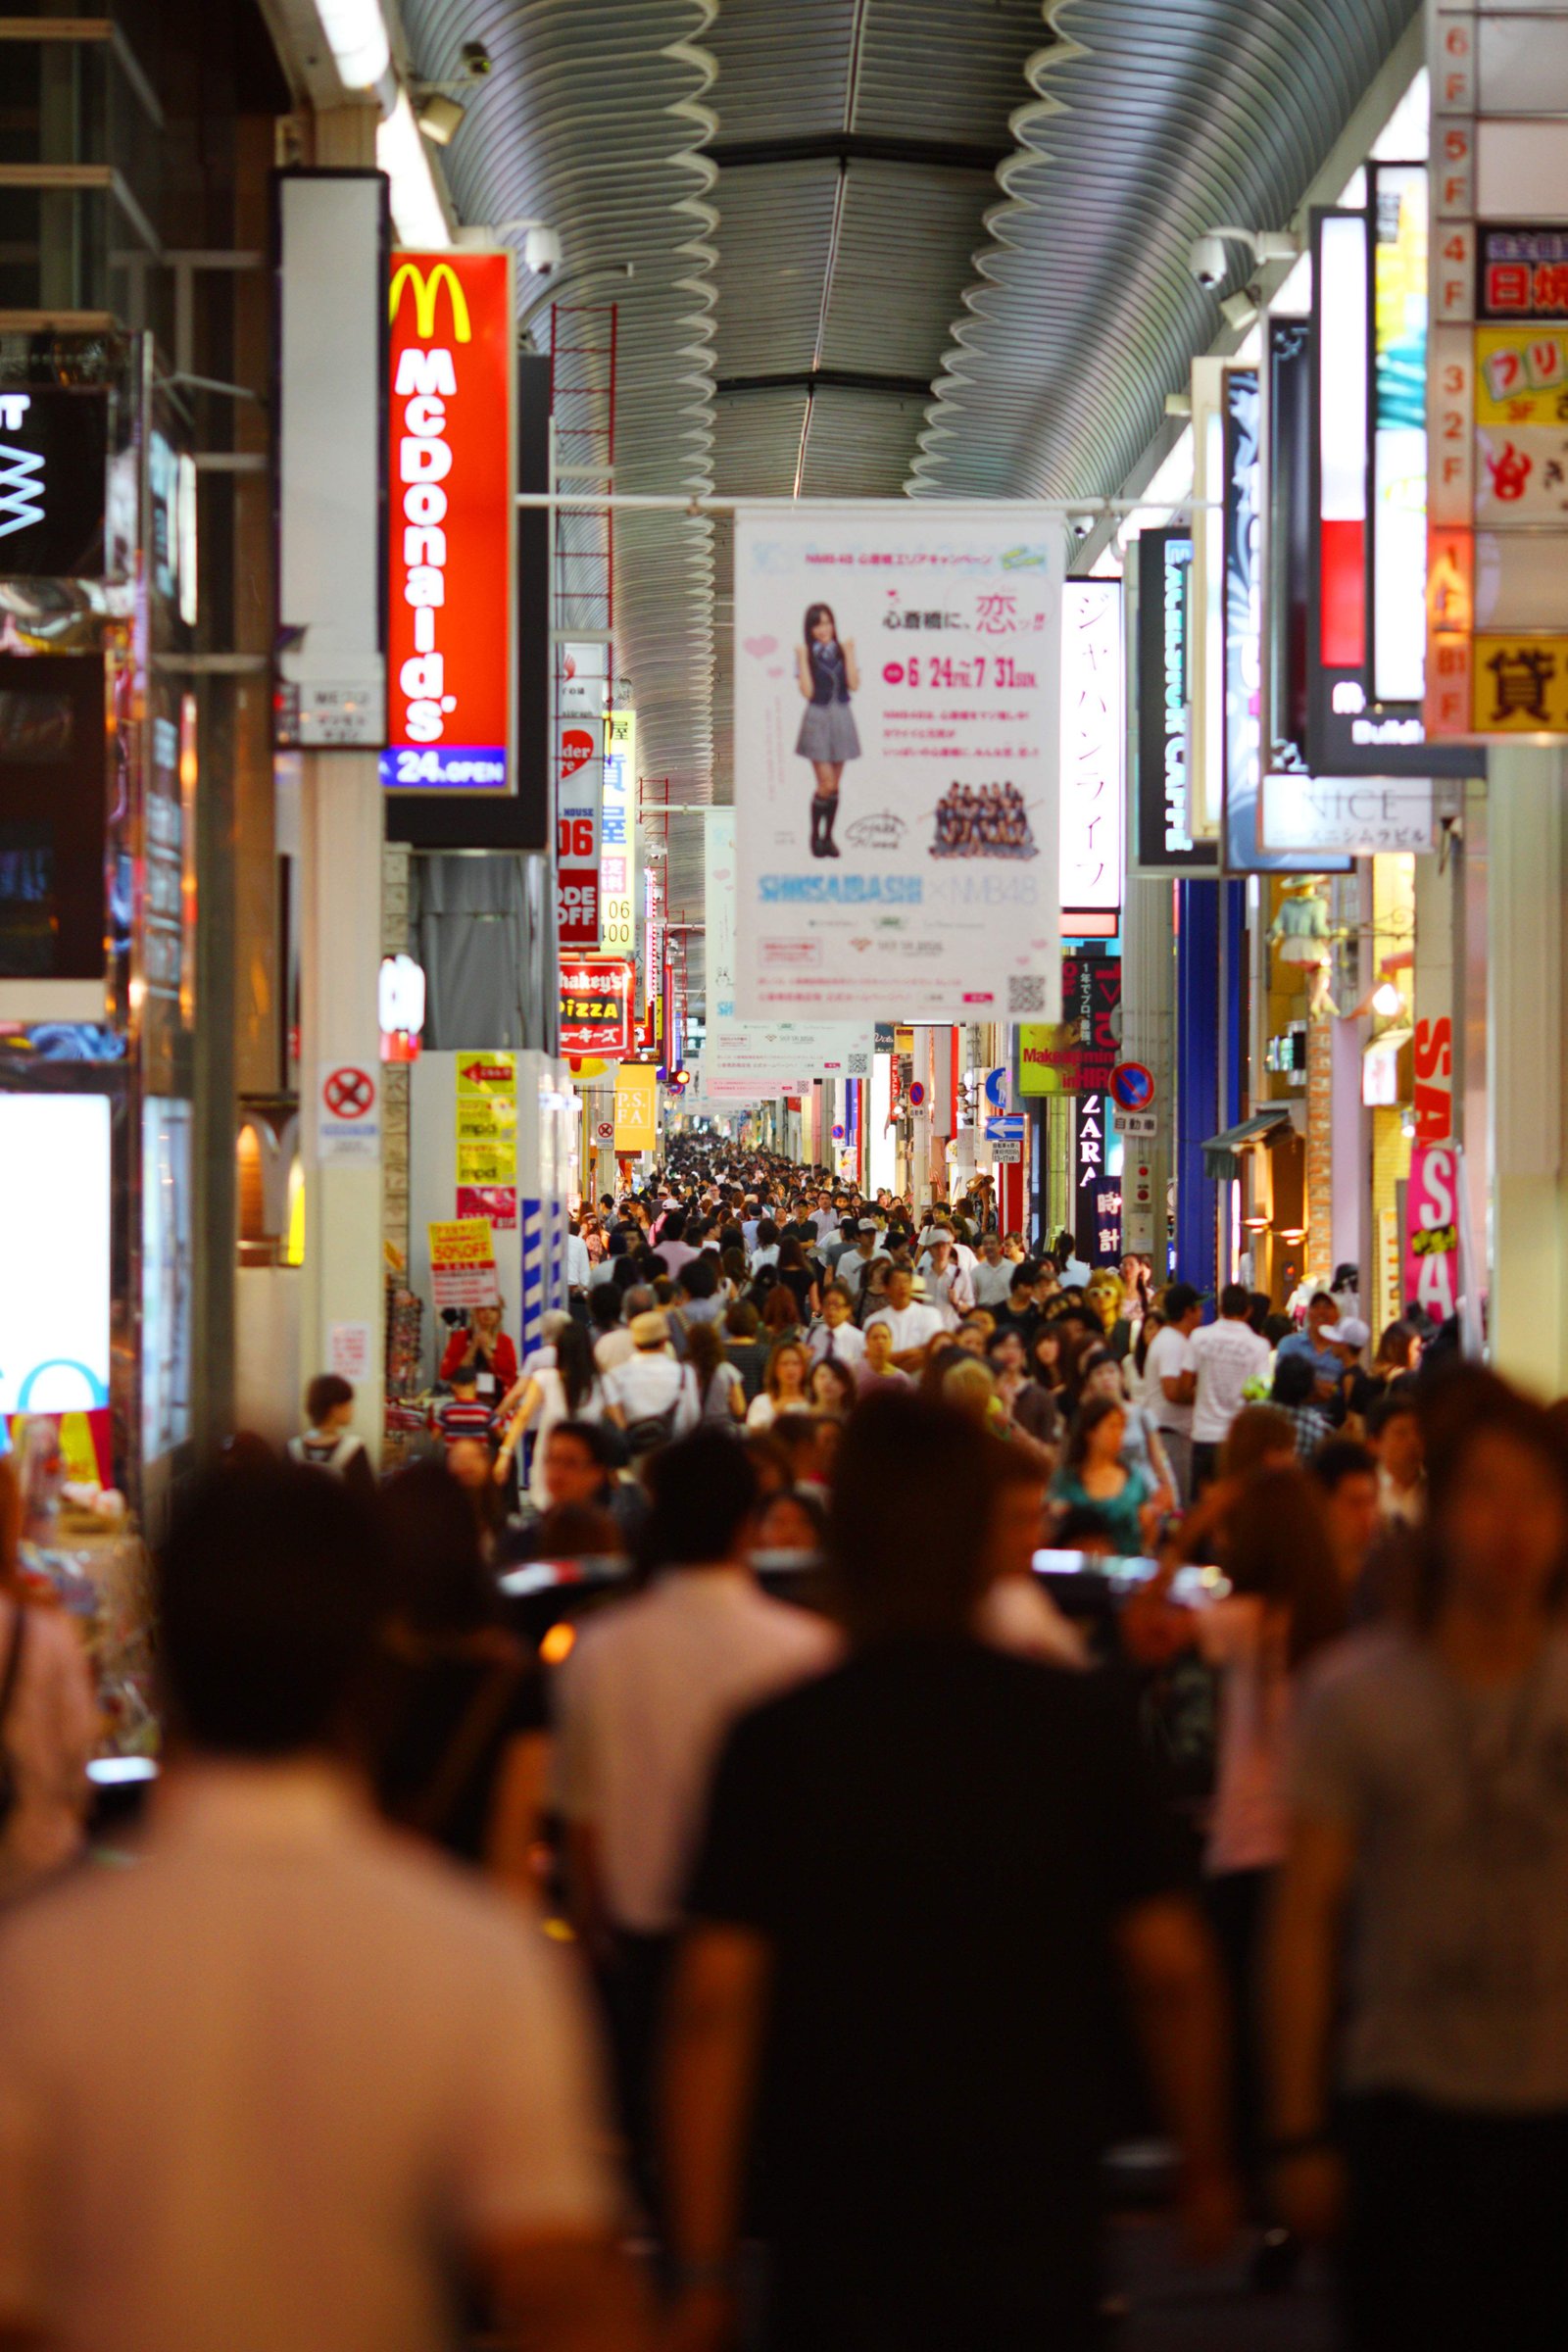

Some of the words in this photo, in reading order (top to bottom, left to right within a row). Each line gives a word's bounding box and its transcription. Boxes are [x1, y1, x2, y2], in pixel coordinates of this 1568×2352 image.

[394, 348, 458, 742] McDonald's
[1079, 1095, 1102, 1188] ZARA
[1097, 1191, 1122, 1252] 時計
